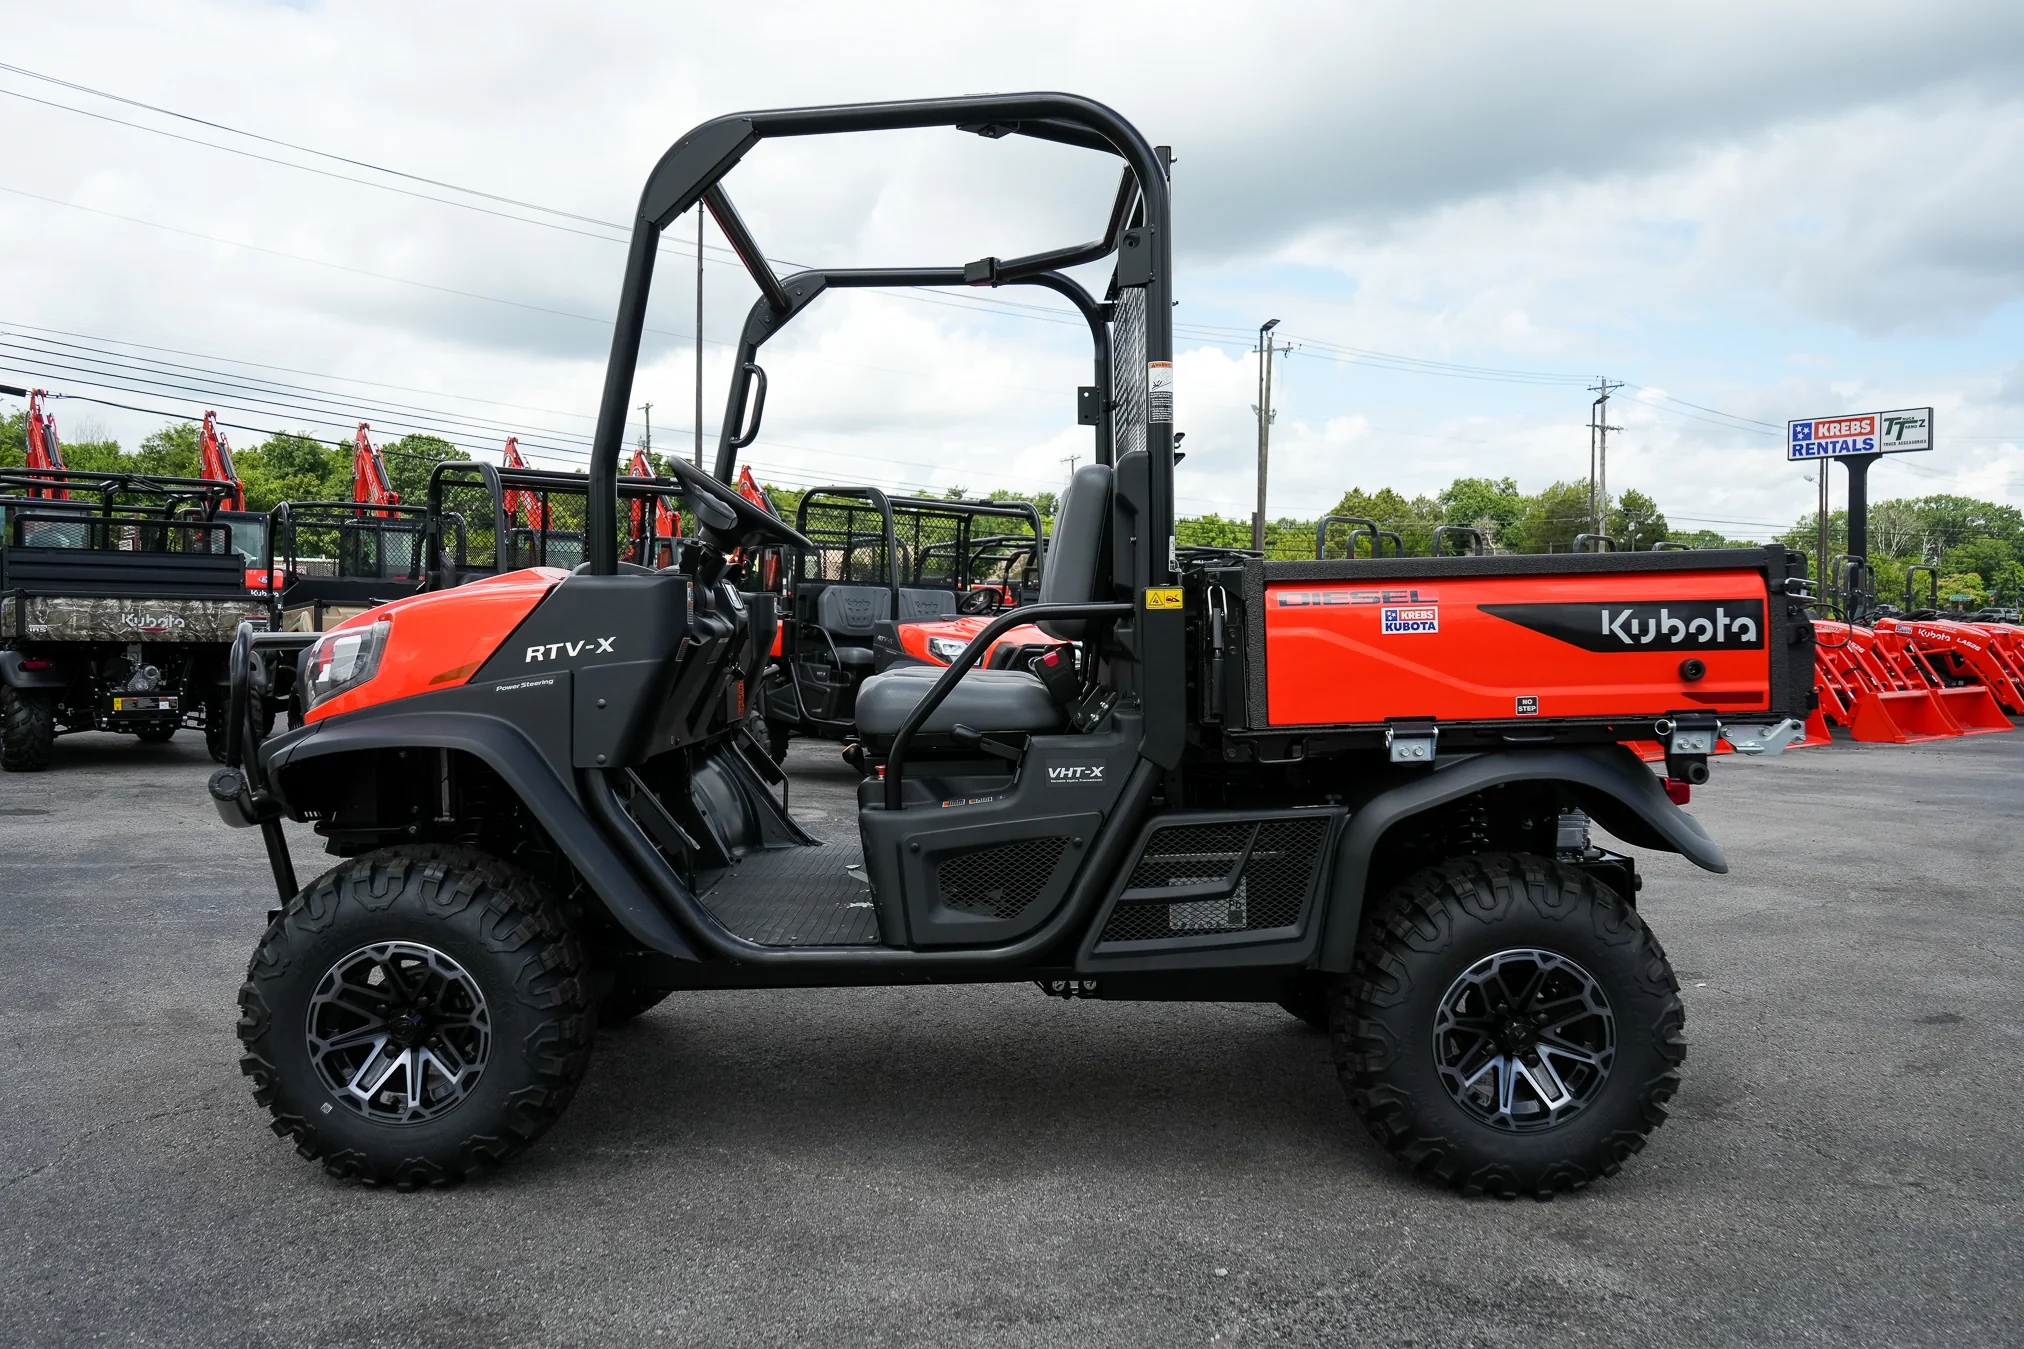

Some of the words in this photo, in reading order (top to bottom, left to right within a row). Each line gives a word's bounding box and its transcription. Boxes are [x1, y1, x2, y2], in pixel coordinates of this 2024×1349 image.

[1818, 420, 1871, 437] KREBS
[1792, 437, 1875, 457] RENTALS
[1279, 590, 1439, 607] DIESEL
[121, 613, 185, 628] Kubota
[1401, 610, 1434, 620] KREBS
[1385, 621, 1437, 632] KUBOTA
[1601, 607, 1757, 644] Kubota
[1918, 628, 1951, 642] Kubota
[525, 636, 617, 663] RTV-X
[495, 683, 520, 692] Power
[520, 679, 554, 690] Steering
[1048, 766, 1105, 778] VHT-X
